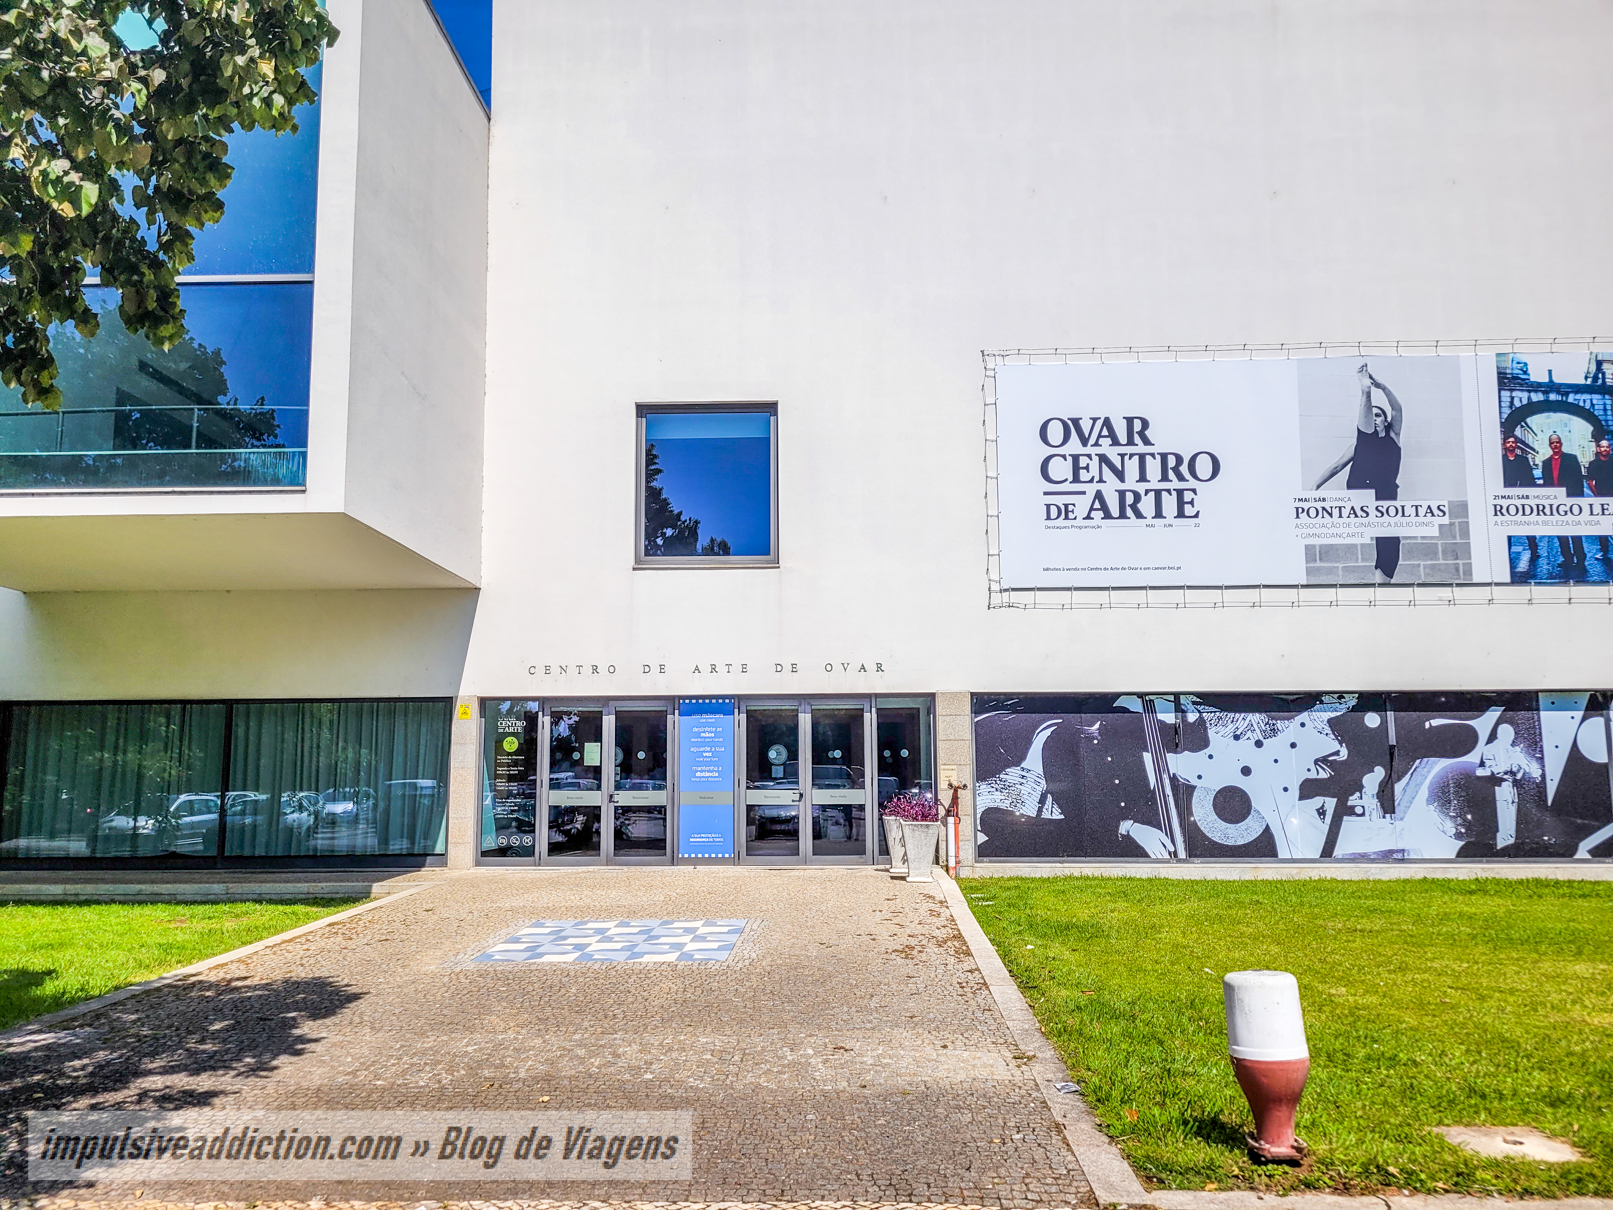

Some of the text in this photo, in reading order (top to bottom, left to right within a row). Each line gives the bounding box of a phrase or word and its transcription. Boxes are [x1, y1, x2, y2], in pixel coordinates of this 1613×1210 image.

[1039, 416, 1155, 448] OVAR
[1040, 451, 1221, 484] CENTRO
[1044, 488, 1200, 521] DE ARTE
[1294, 504, 1447, 519] PONTAS SOLTAS
[1492, 502, 1613, 517] RODRIGO LE
[1294, 521, 1341, 530] ASSOCIAÇÃO
[1353, 520, 1392, 529] GINÁSTICA
[1393, 520, 1414, 528] JÚLIO
[1300, 532, 1365, 540] GIMNODANÇARTE
[528, 662, 885, 675] CENTRO DE ARTE DE OVAR
